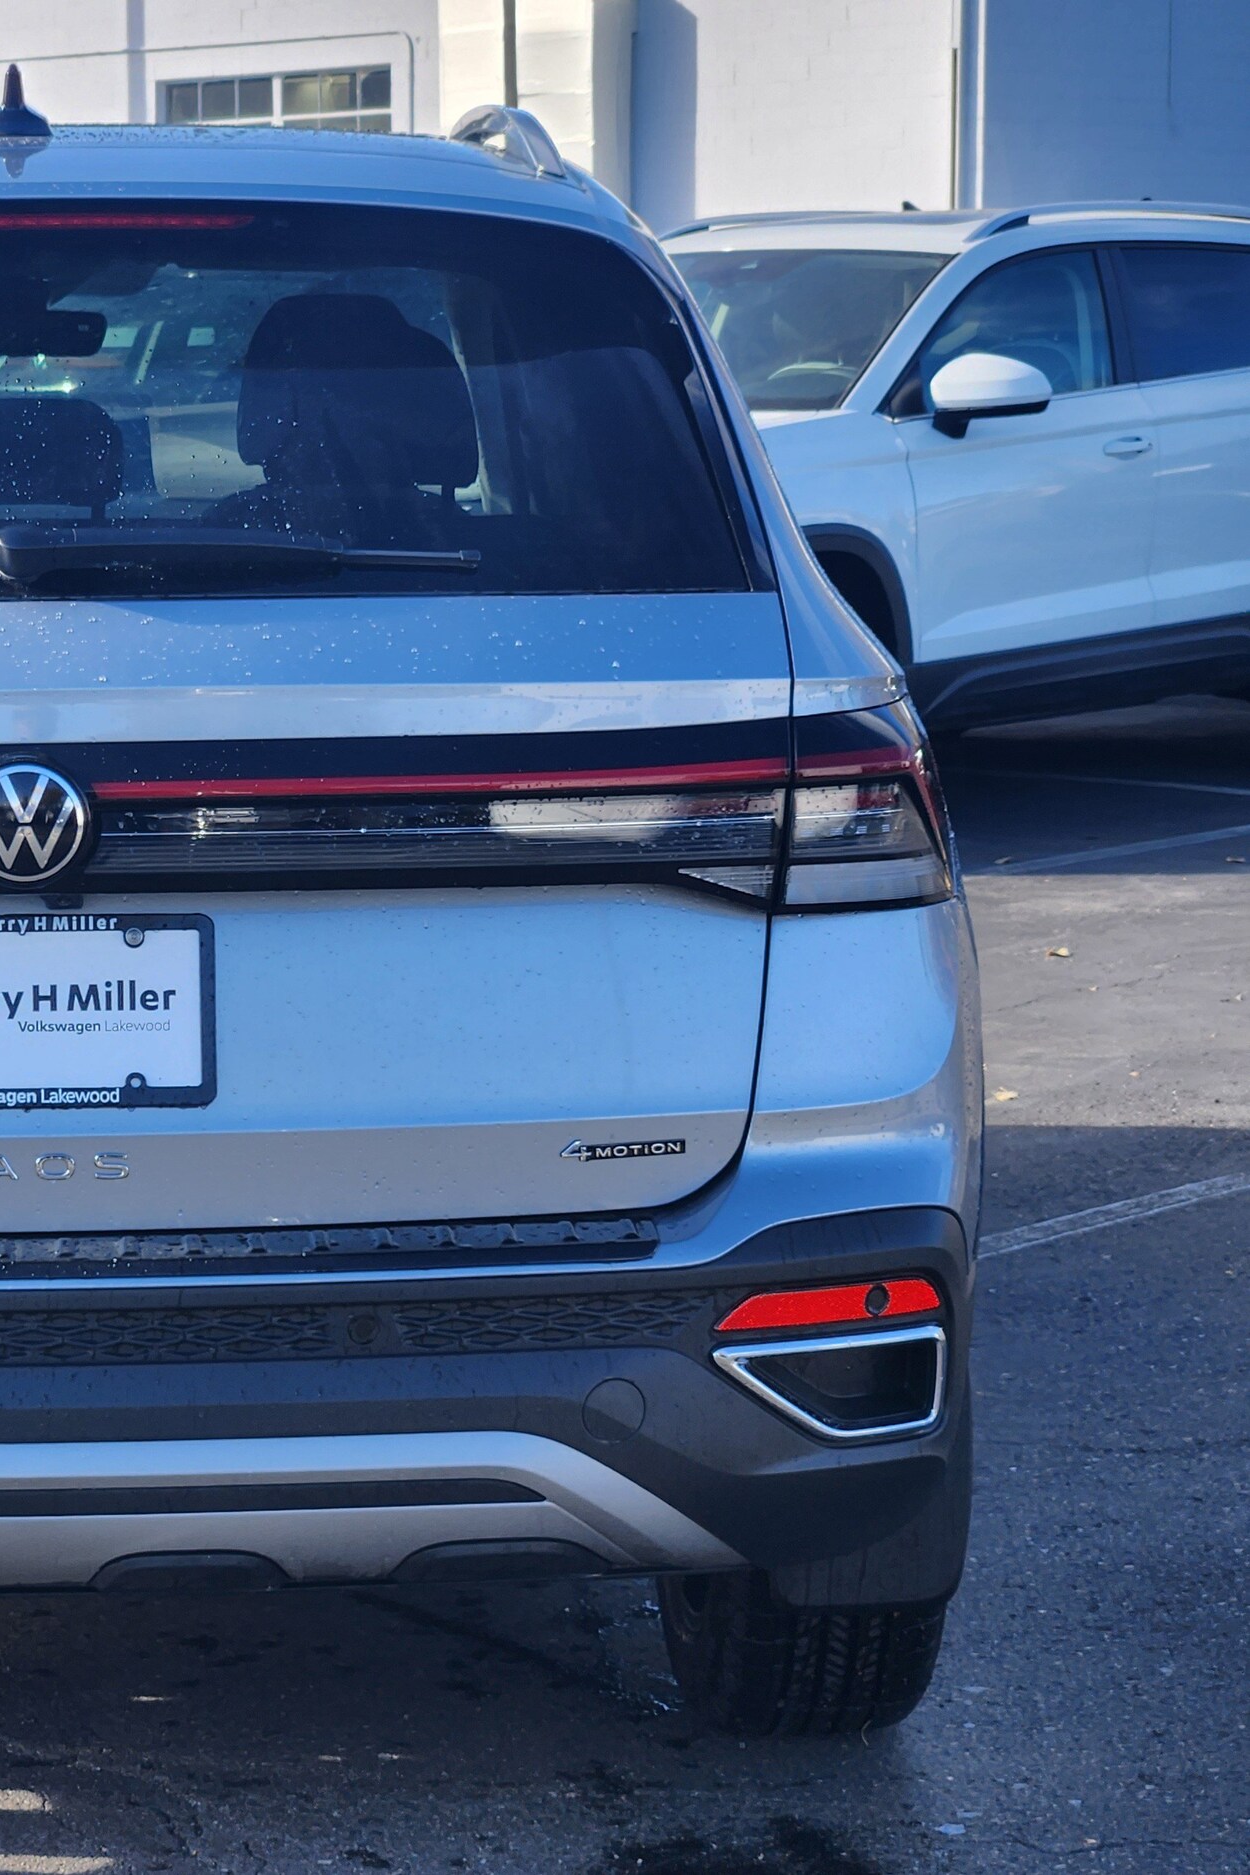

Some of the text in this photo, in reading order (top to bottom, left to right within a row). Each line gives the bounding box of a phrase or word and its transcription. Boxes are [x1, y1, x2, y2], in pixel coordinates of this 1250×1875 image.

[34, 916, 47, 931] H
[52, 915, 117, 931] Miller
[32, 984, 57, 1012] H
[67, 980, 176, 1012] Miller
[17, 1019, 171, 1034] Volkswagen Lakewood
[40, 1088, 120, 1104] Lakewood
[560, 1139, 682, 1161] 4MOTION
